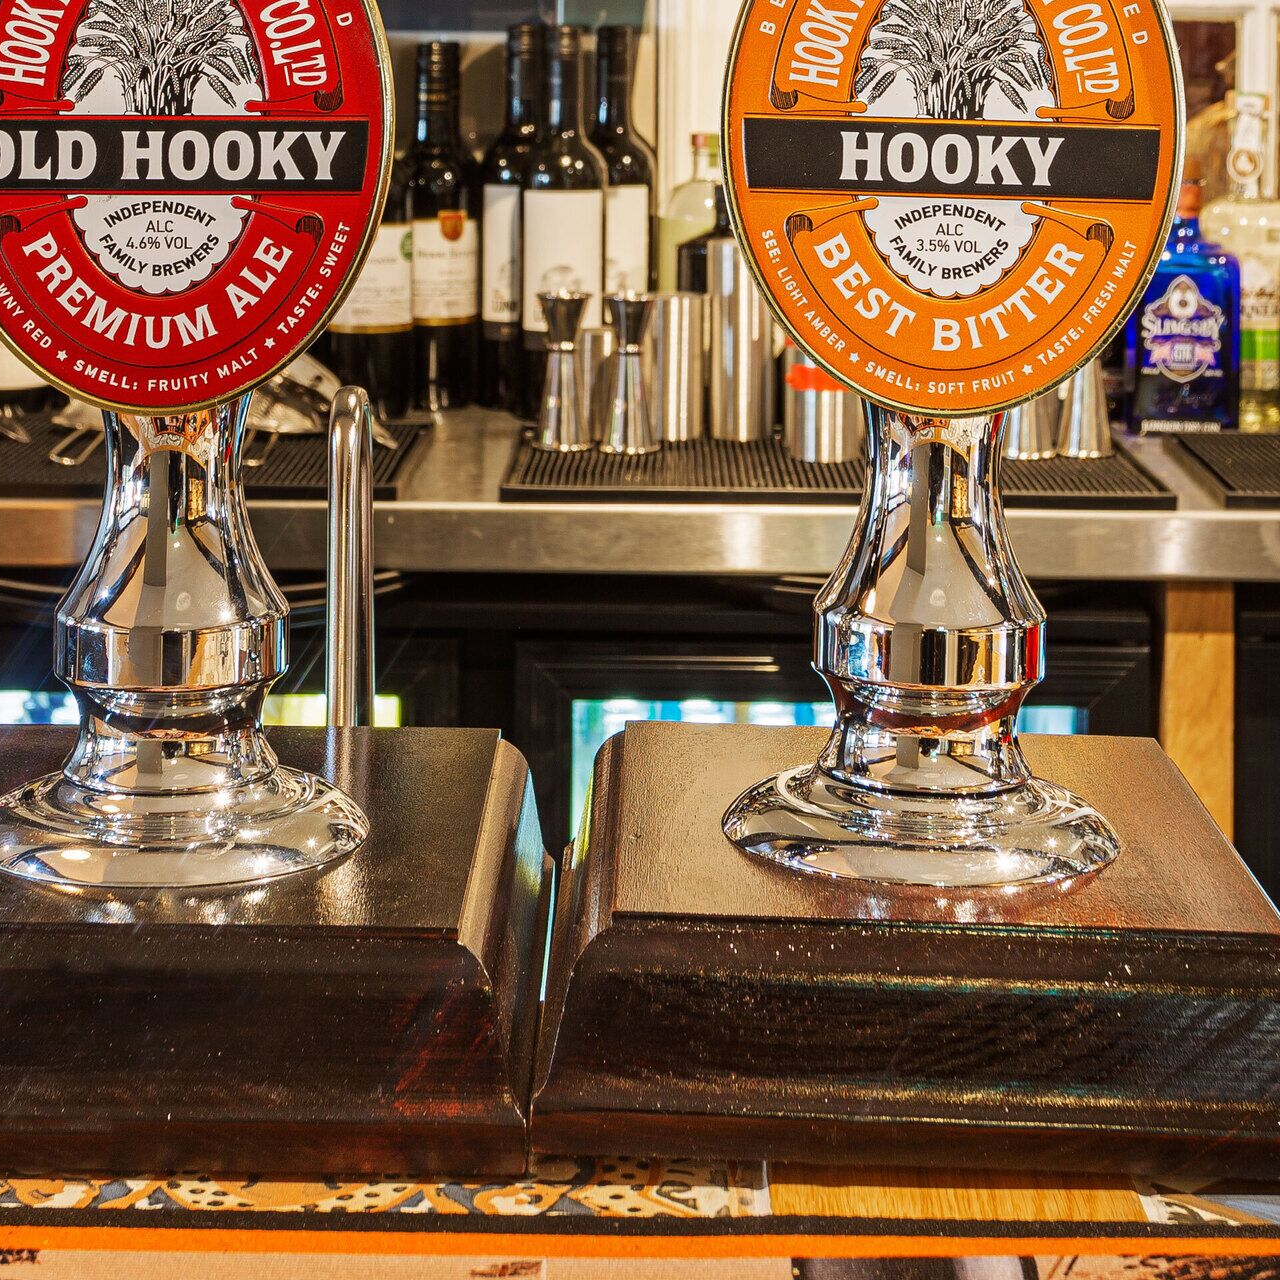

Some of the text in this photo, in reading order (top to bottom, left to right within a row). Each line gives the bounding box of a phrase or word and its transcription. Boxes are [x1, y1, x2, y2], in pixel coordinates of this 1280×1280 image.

[121, 131, 346, 180] HOOKY
[839, 132, 1065, 186] HOOKY
[104, 199, 218, 228] INDEPENDENT
[145, 220, 174, 233] ALC
[893, 204, 1007, 234] INDEPENDENT
[935, 223, 964, 237] ALC
[99, 233, 220, 277] FAMILY BREWERS
[126, 236, 193, 251] 4.6% VOL
[889, 235, 1009, 280] FAMILY BREWERS
[916, 239, 982, 254] 3.5% VOL
[22, 232, 293, 349] PREMIUM ALE
[23, 320, 51, 348] RED
[74, 360, 137, 390] SMELL:
[148, 372, 208, 391] FRUITY
[217, 348, 257, 378] MALT
[278, 283, 322, 333] TASTE:
[320, 223, 350, 277] SWEET
[762, 230, 1136, 394] SEE: LIGHT AMBER SMELL: SOFT FRUIT TASTE: FRESH MALT
[814, 232, 1084, 351] BEST BITTER
